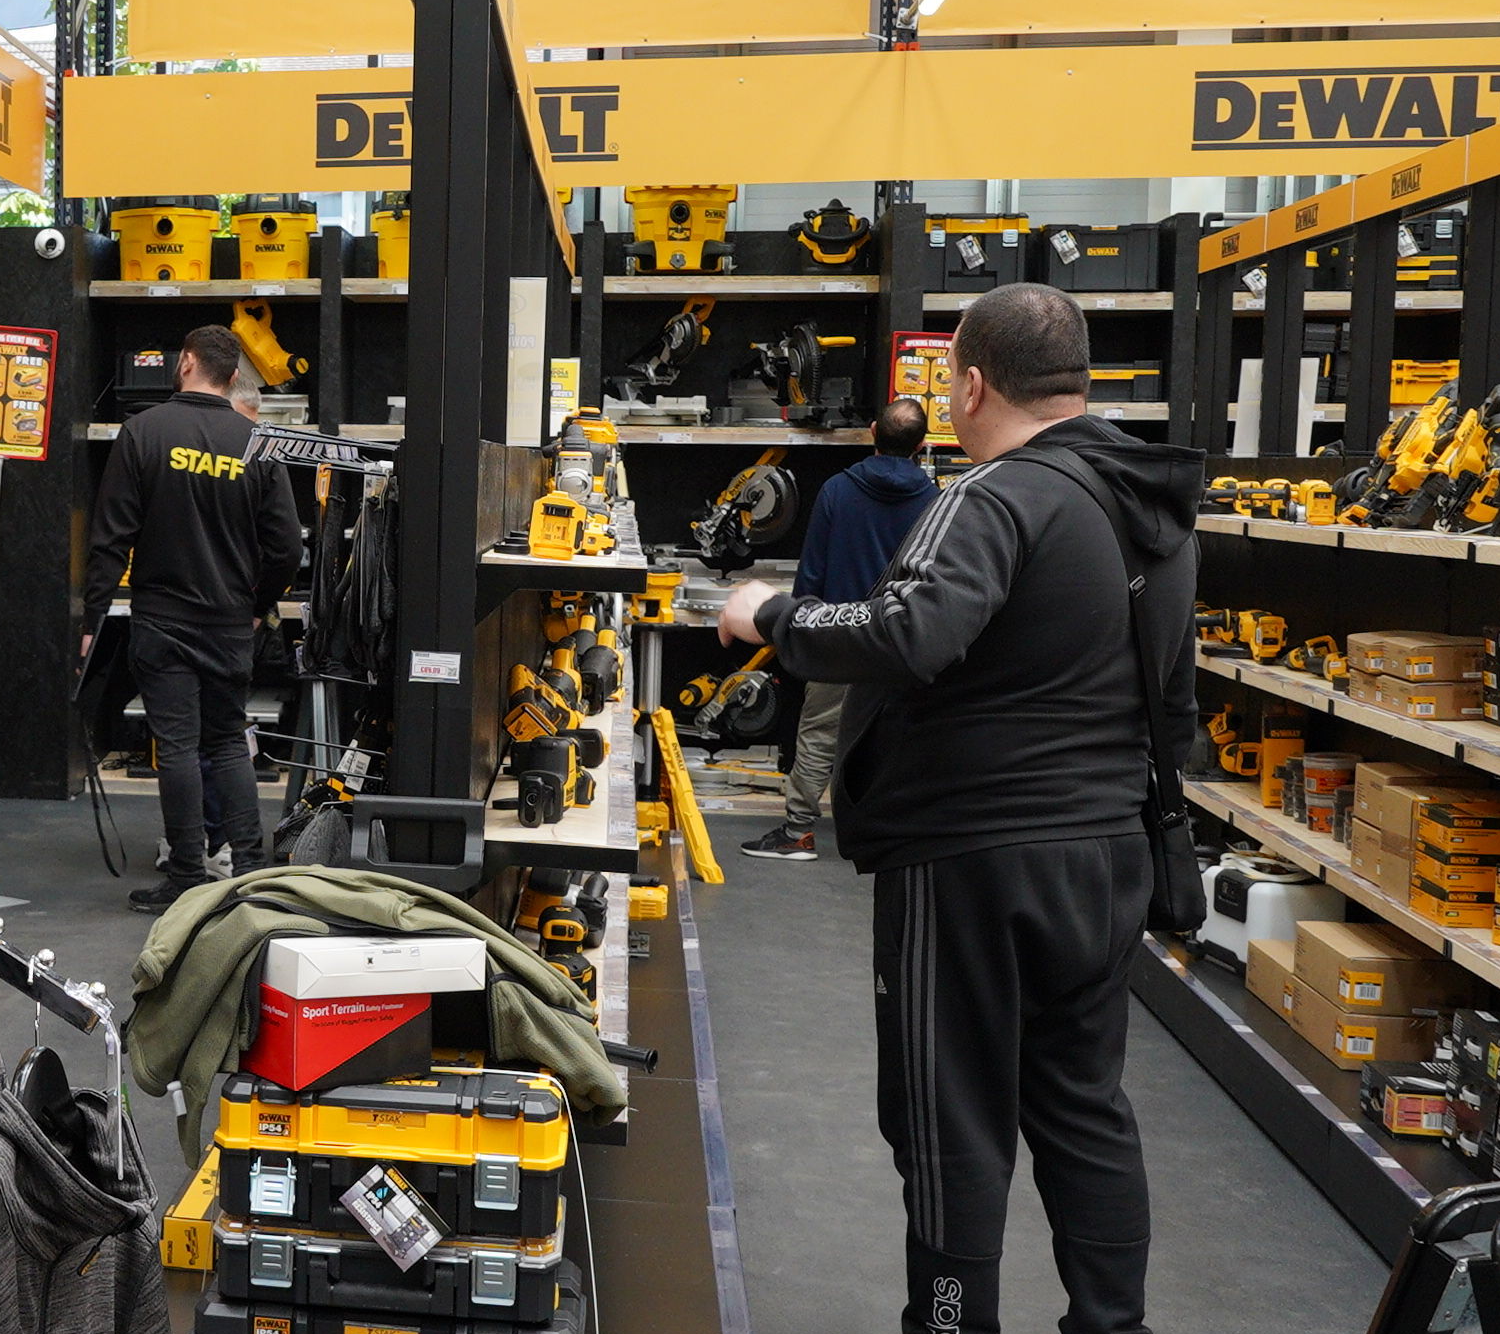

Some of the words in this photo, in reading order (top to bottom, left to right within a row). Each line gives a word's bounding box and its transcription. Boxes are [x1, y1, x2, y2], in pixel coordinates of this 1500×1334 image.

[317, 95, 619, 158] DELT
[146, 243, 184, 255] DEWALT
[254, 242, 286, 254] DEWALT
[1087, 246, 1119, 257] DEWALT
[15, 355, 43, 366] FREE
[902, 356, 925, 366] FREE
[12, 400, 40, 411] FREE
[170, 447, 246, 481] STAFF
[303, 1002, 329, 1019] Sport
[332, 1001, 366, 1016] Terrain
[258, 1113, 292, 1124] DEWALT
[258, 1123, 283, 1134] IP54
[256, 1318, 290, 1329] DEWALT
